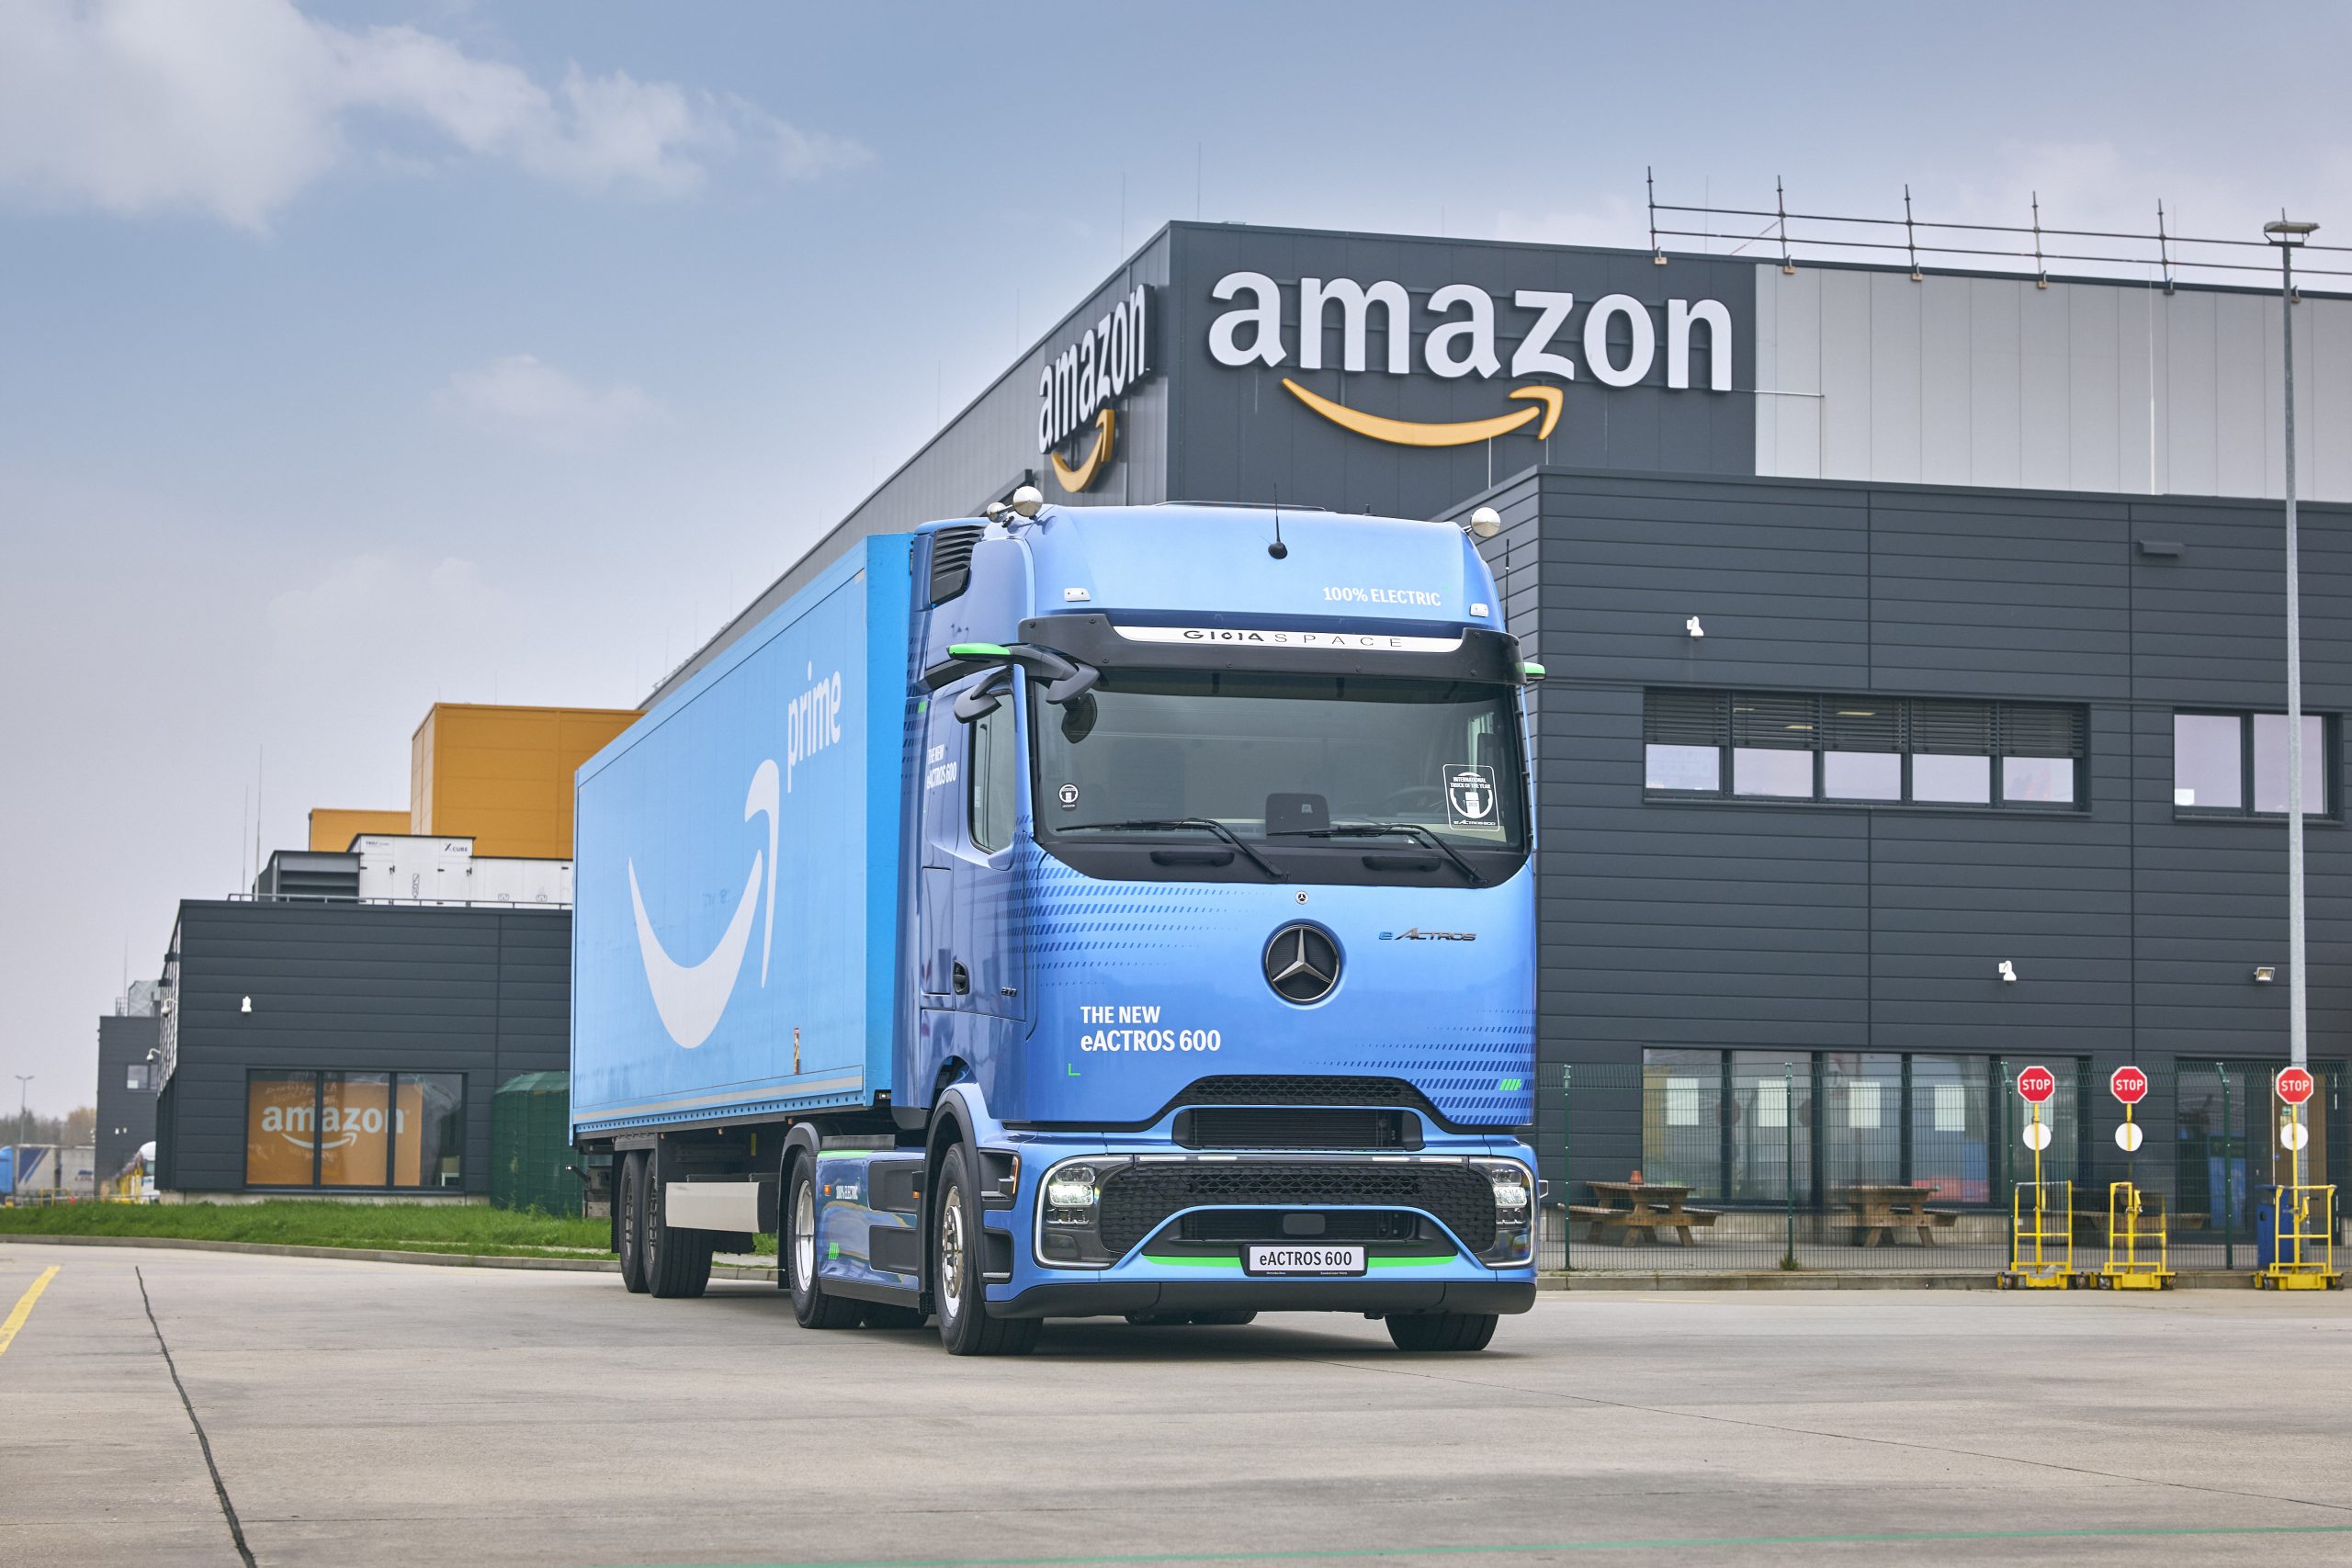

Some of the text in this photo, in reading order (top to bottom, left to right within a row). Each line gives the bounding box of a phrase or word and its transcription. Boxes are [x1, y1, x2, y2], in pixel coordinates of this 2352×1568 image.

[1208, 271, 1733, 392] amazon
[1038, 284, 1146, 455] amazon
[1323, 586, 1442, 606] 100% ELECTRIC
[787, 660, 842, 794] prime
[946, 761, 957, 783] 600
[1080, 1006, 1161, 1024] THE NEW
[1080, 1029, 1221, 1052] eACTROS 600
[2022, 1078, 2051, 1091] STOP
[2116, 1079, 2143, 1091] STOP
[2281, 1079, 2310, 1092] STOP
[261, 1106, 404, 1134] amazon
[1260, 1251, 1352, 1266] eACTROS 600
